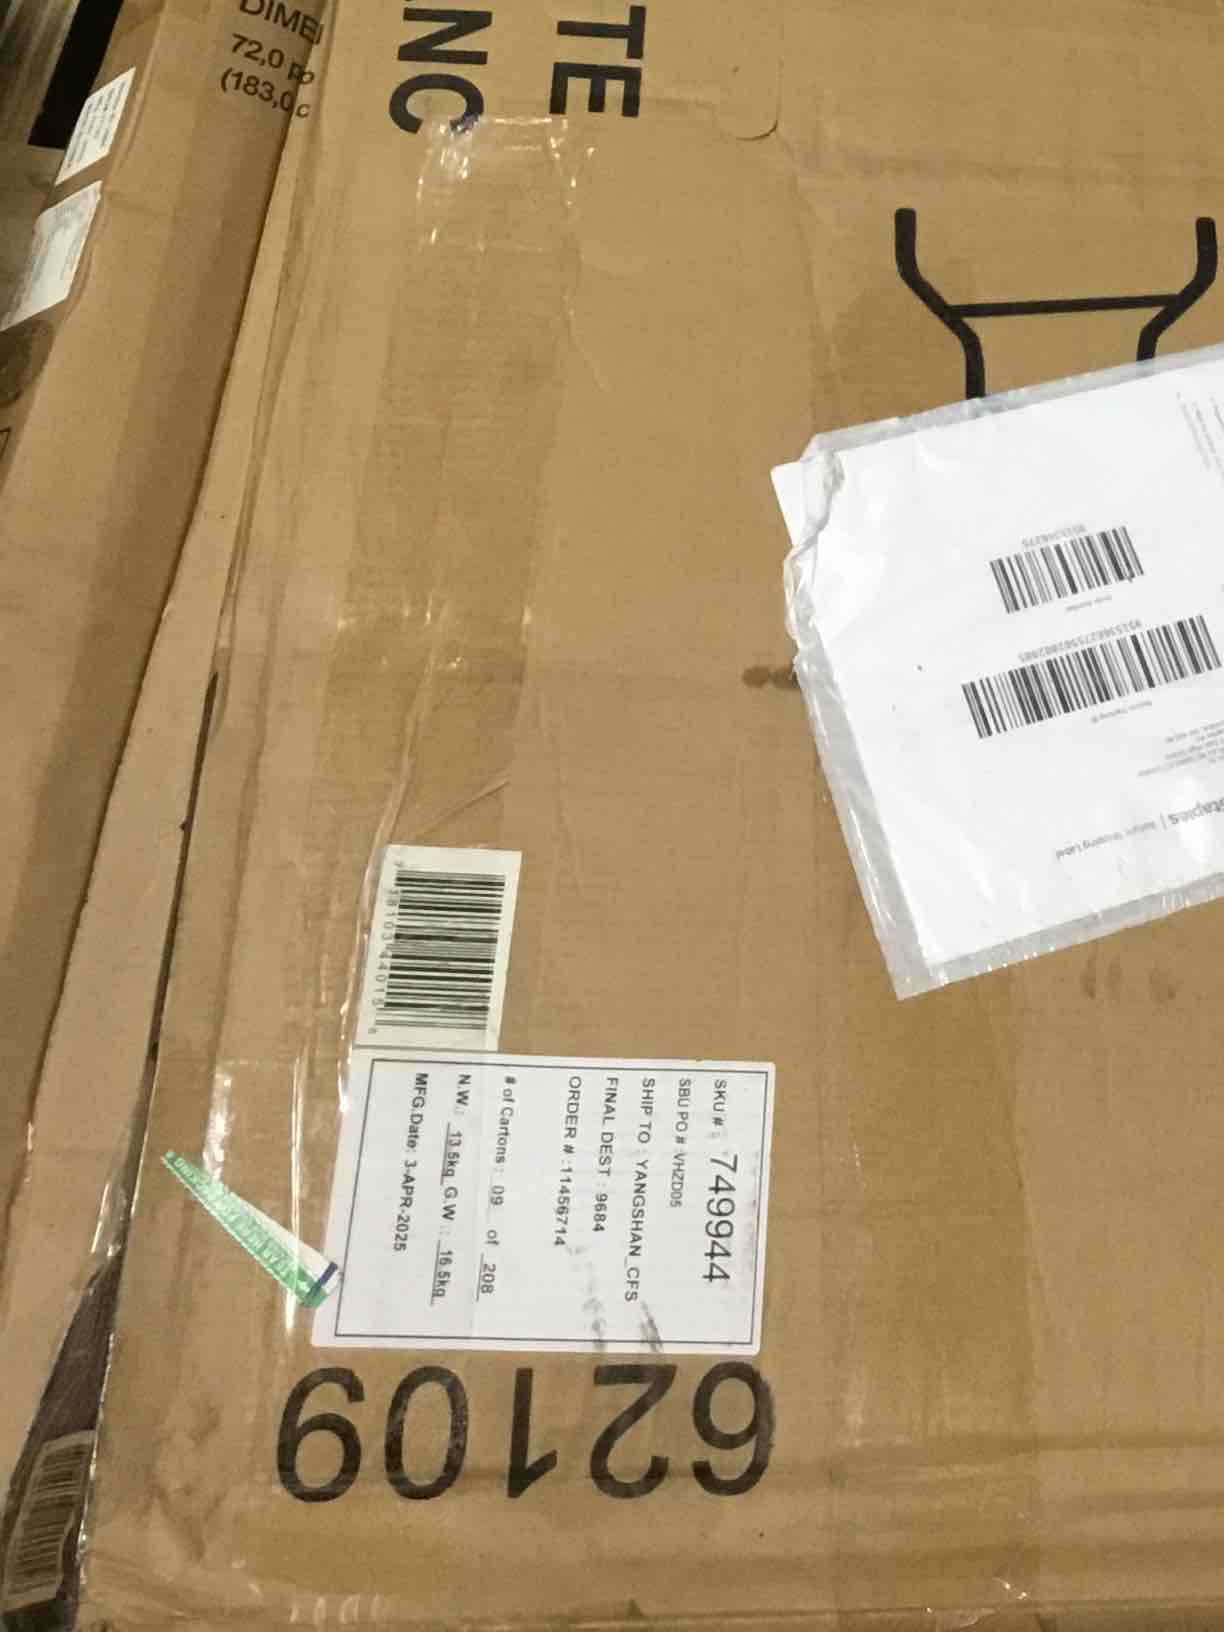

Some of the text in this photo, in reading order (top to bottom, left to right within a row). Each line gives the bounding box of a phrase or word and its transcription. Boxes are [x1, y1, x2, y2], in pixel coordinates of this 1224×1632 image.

[231, 33, 285, 69] 72,0
[220, 67, 295, 113] (183,0
[502, 1087, 516, 1105] of
[563, 1075, 583, 1141] ORDER
[602, 1076, 620, 1127] FINAL
[639, 1077, 655, 1117] SHIP
[676, 1077, 692, 1108] SBU
[712, 1079, 728, 1113] SKU
[494, 1105, 515, 1165] Cartons
[637, 1121, 653, 1145] TO
[675, 1111, 689, 1133] PO
[598, 1131, 616, 1177] DEST
[392, 1159, 418, 1252] 3-APR-2025
[489, 1184, 506, 1207] 09
[591, 1192, 609, 1234] 9684
[484, 1228, 500, 1246] of
[623, 1159, 650, 1304] YANGSHAN_CFS
[701, 1154, 739, 1283] 749944
[479, 1262, 497, 1295] 208
[276, 1361, 776, 1504] 62109
